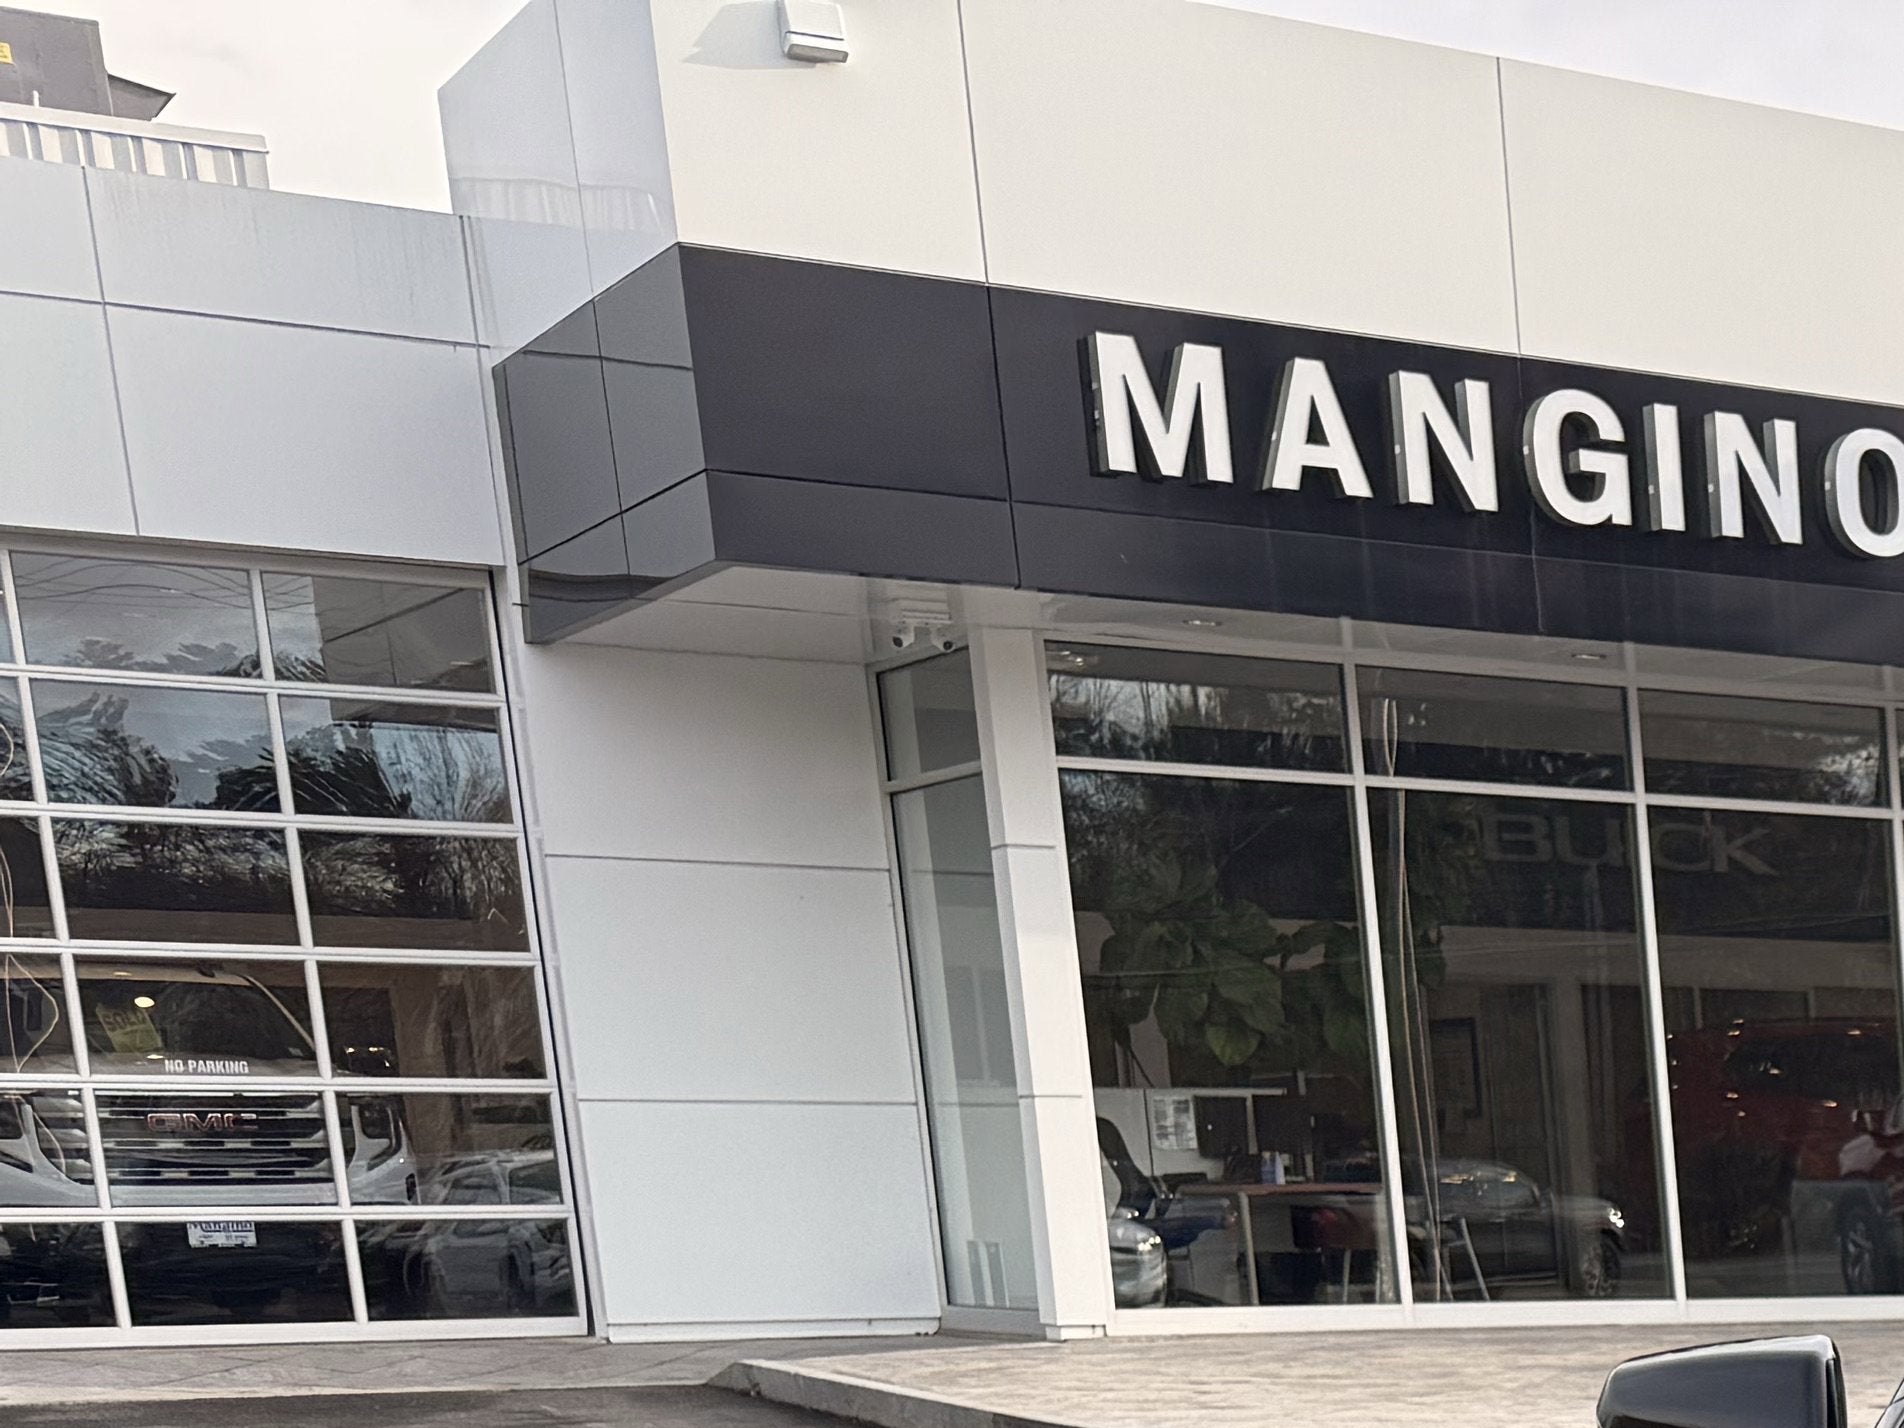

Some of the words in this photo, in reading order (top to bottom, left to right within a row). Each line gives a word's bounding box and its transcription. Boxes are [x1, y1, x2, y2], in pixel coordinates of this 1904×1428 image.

[1484, 812, 1781, 877] BUCK
[164, 1058, 185, 1074] NO
[188, 1058, 250, 1075] PARKING
[146, 1112, 259, 1133] GMC
